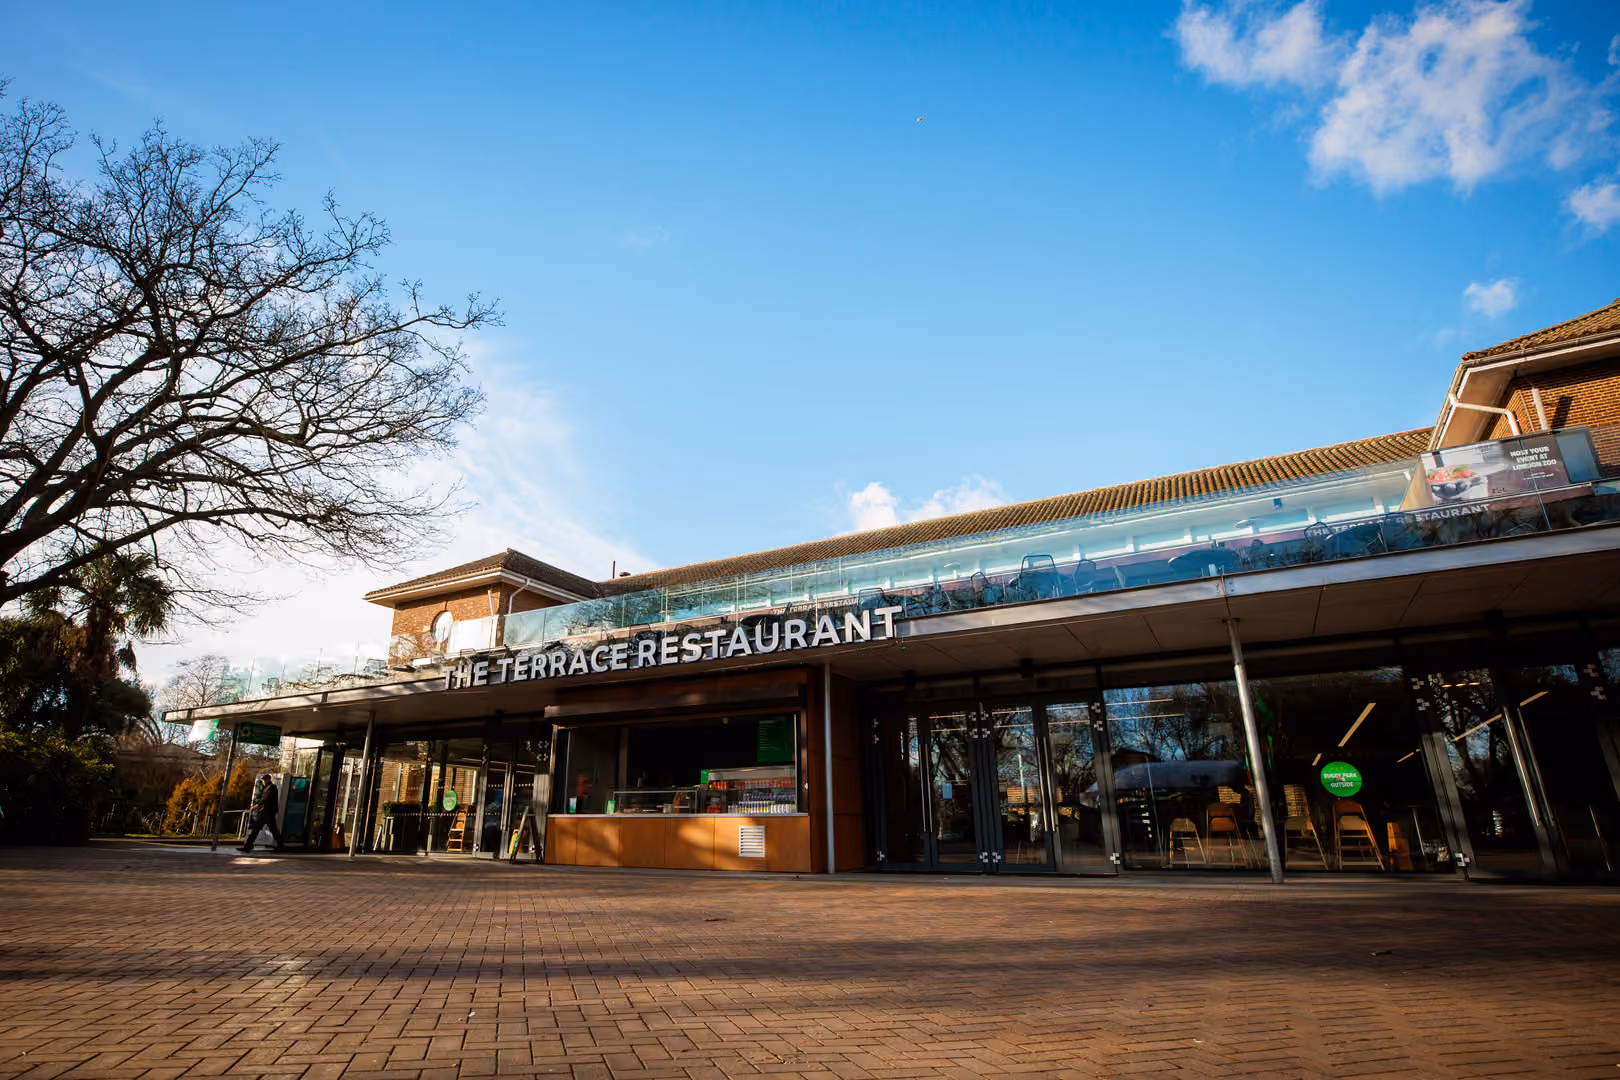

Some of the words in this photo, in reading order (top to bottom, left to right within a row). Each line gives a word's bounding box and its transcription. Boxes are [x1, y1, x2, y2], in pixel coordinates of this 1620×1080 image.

[1510, 449, 1528, 457] HOST
[1529, 446, 1549, 454] YOUR
[1516, 454, 1538, 463] EVENT
[443, 661, 488, 690] THE
[497, 643, 627, 682] TERRACE
[634, 606, 902, 667] RESTAURANT
